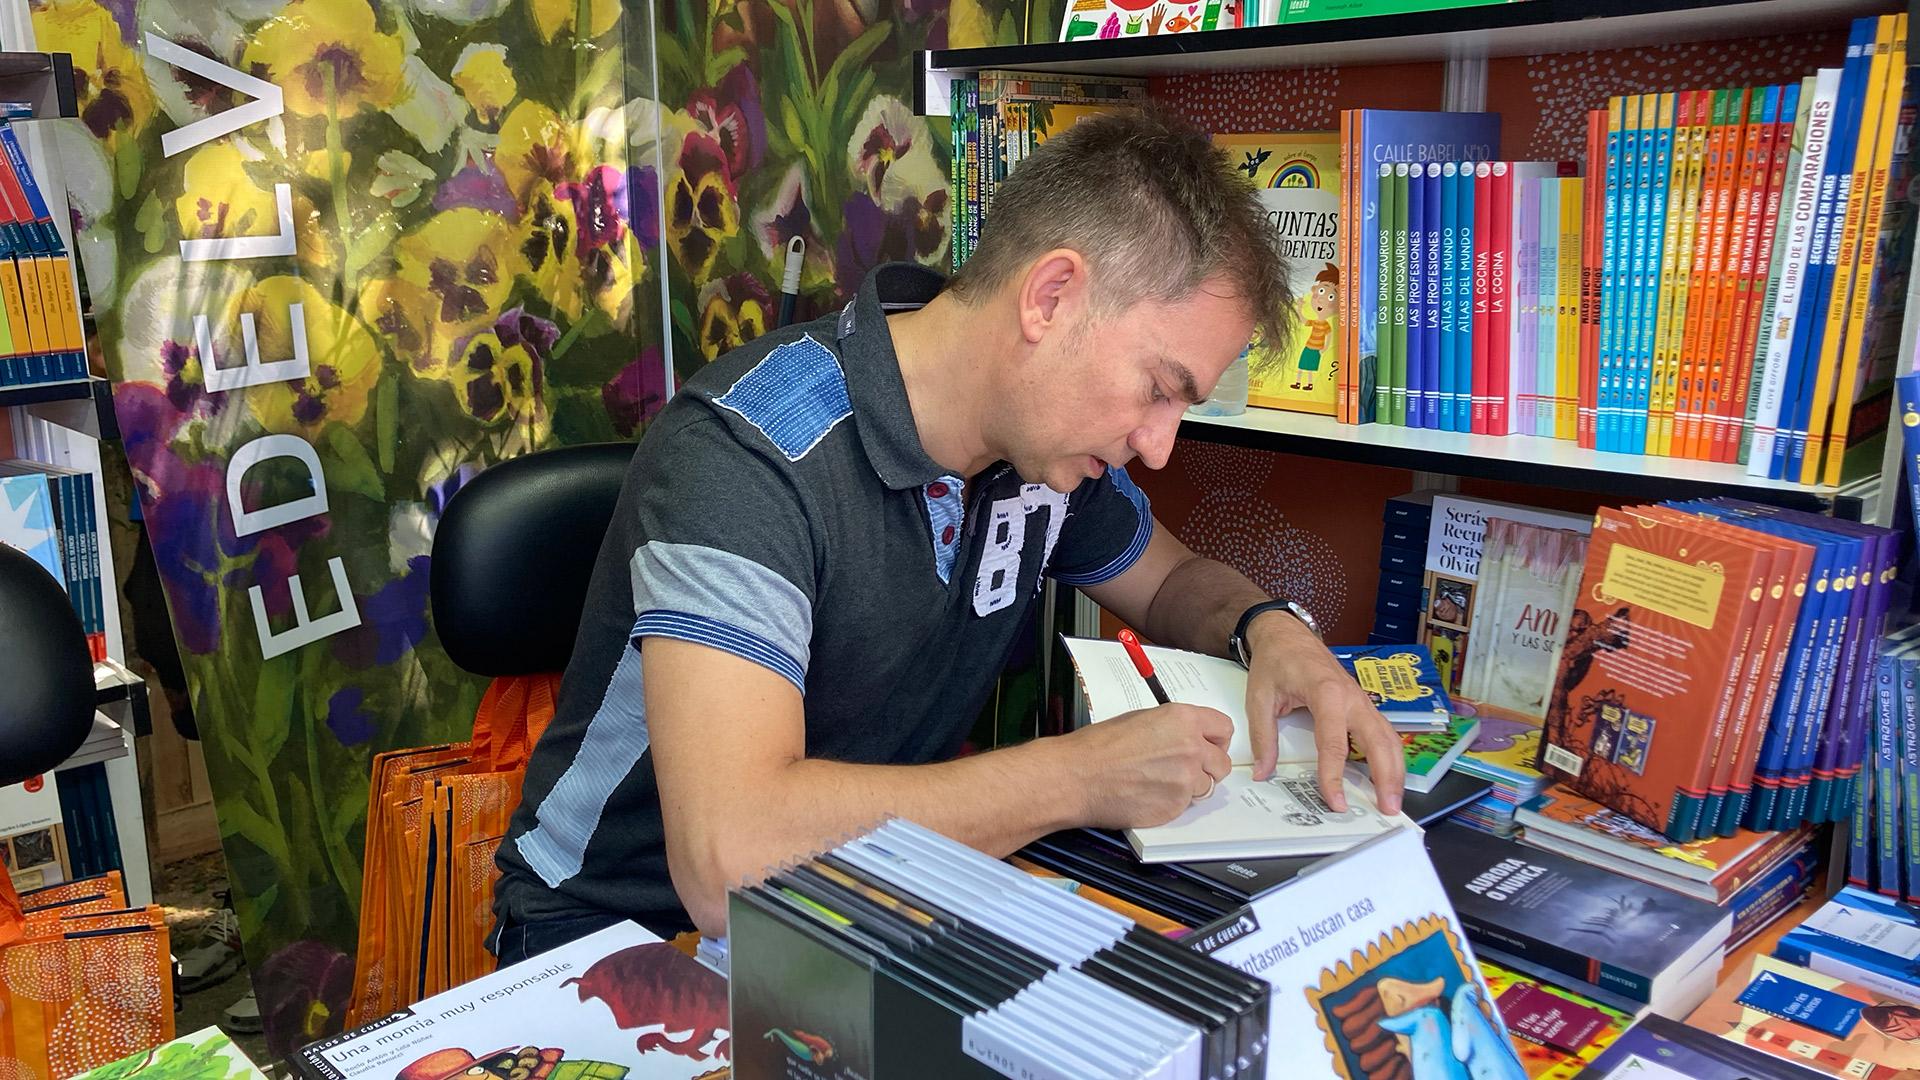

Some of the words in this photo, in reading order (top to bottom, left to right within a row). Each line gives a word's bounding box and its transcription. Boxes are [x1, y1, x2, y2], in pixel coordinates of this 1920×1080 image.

[1374, 144, 1413, 162] CALLE
[1794, 99, 1831, 223] COMPARACIONES
[1820, 173, 1837, 202] PARÍS
[1836, 172, 1852, 201] PARÍS
[1852, 170, 1866, 195] YORK
[1872, 168, 1886, 194] YORK
[1606, 195, 1615, 217] TIEMPO
[1652, 193, 1663, 216] TIEMPO
[1717, 189, 1729, 214] TIEMPO
[1766, 191, 1780, 217] TIEMPO
[1818, 201, 1832, 215] EN
[1834, 200, 1847, 215] EN
[1847, 197, 1862, 227] NUEVA
[1867, 195, 1882, 225] NUEVA
[1605, 229, 1614, 237] EN
[1650, 227, 1660, 236] EN
[1714, 225, 1725, 235] EN
[1762, 227, 1773, 238] EN
[1793, 225, 1806, 243] LAS
[1809, 215, 1829, 266] SECUESTRO
[1826, 215, 1844, 265] SECUESTRO
[1845, 227, 1857, 241] EN
[1865, 225, 1877, 239] EN
[1443, 228, 1453, 270] MUNDO
[1461, 228, 1470, 270] MUNDO
[1605, 239, 1614, 258] VIAJA
[1649, 238, 1659, 257] VIAJA
[1712, 236, 1723, 257] VIAJA
[1759, 238, 1771, 260] VIAJA
[1790, 246, 1802, 259] DE
[1840, 242, 1854, 267] ROBO
[1861, 240, 1875, 266] ROBO
[1379, 230, 1389, 300] DINOSAURIOS
[1395, 230, 1406, 301] DINOSAURIOS
[1409, 231, 1420, 304] PROFESIONES
[1427, 231, 1439, 304] PROFESIONES
[1476, 251, 1487, 295] COCINA
[1492, 251, 1504, 295] COCINA
[1604, 259, 1613, 272] TOM
[1648, 258, 1658, 272] TOM
[1710, 257, 1721, 272] TOM
[1756, 259, 1768, 275] TOM
[1443, 276, 1452, 294] DEL
[1460, 276, 1469, 295] DEL
[1785, 262, 1799, 290] LIBRO
[1475, 300, 1486, 313] LA
[1491, 300, 1503, 313] LA
[1782, 292, 1794, 305] EL
[1379, 306, 1387, 324] LOS
[1395, 306, 1404, 325] LOS
[1409, 308, 1419, 327] LAS
[1427, 309, 1437, 328] LAS
[1442, 300, 1452, 332] ATLAS
[1459, 300, 1469, 332] ATLAS
[1769, 351, 1782, 386] GIFFORD
[1765, 388, 1776, 410] CLIVE
[68, 535, 76, 556] SILENCIO
[1441, 541, 1482, 559] serás
[70, 562, 78, 581] ROMPER
[1465, 858, 1528, 895] AURORA
[1486, 891, 1507, 902] O
[1502, 865, 1548, 896] NUNCA
[1297, 911, 1346, 948] buscan
[1346, 897, 1377, 922] casa
[1204, 936, 1216, 950] DE
[331, 1044, 370, 1062] Una
[375, 1018, 436, 1046] momia
[440, 1001, 476, 1020] muy
[480, 962, 574, 1003] responsable
[303, 1039, 339, 1057] MALOS
[343, 1032, 357, 1040] DE
